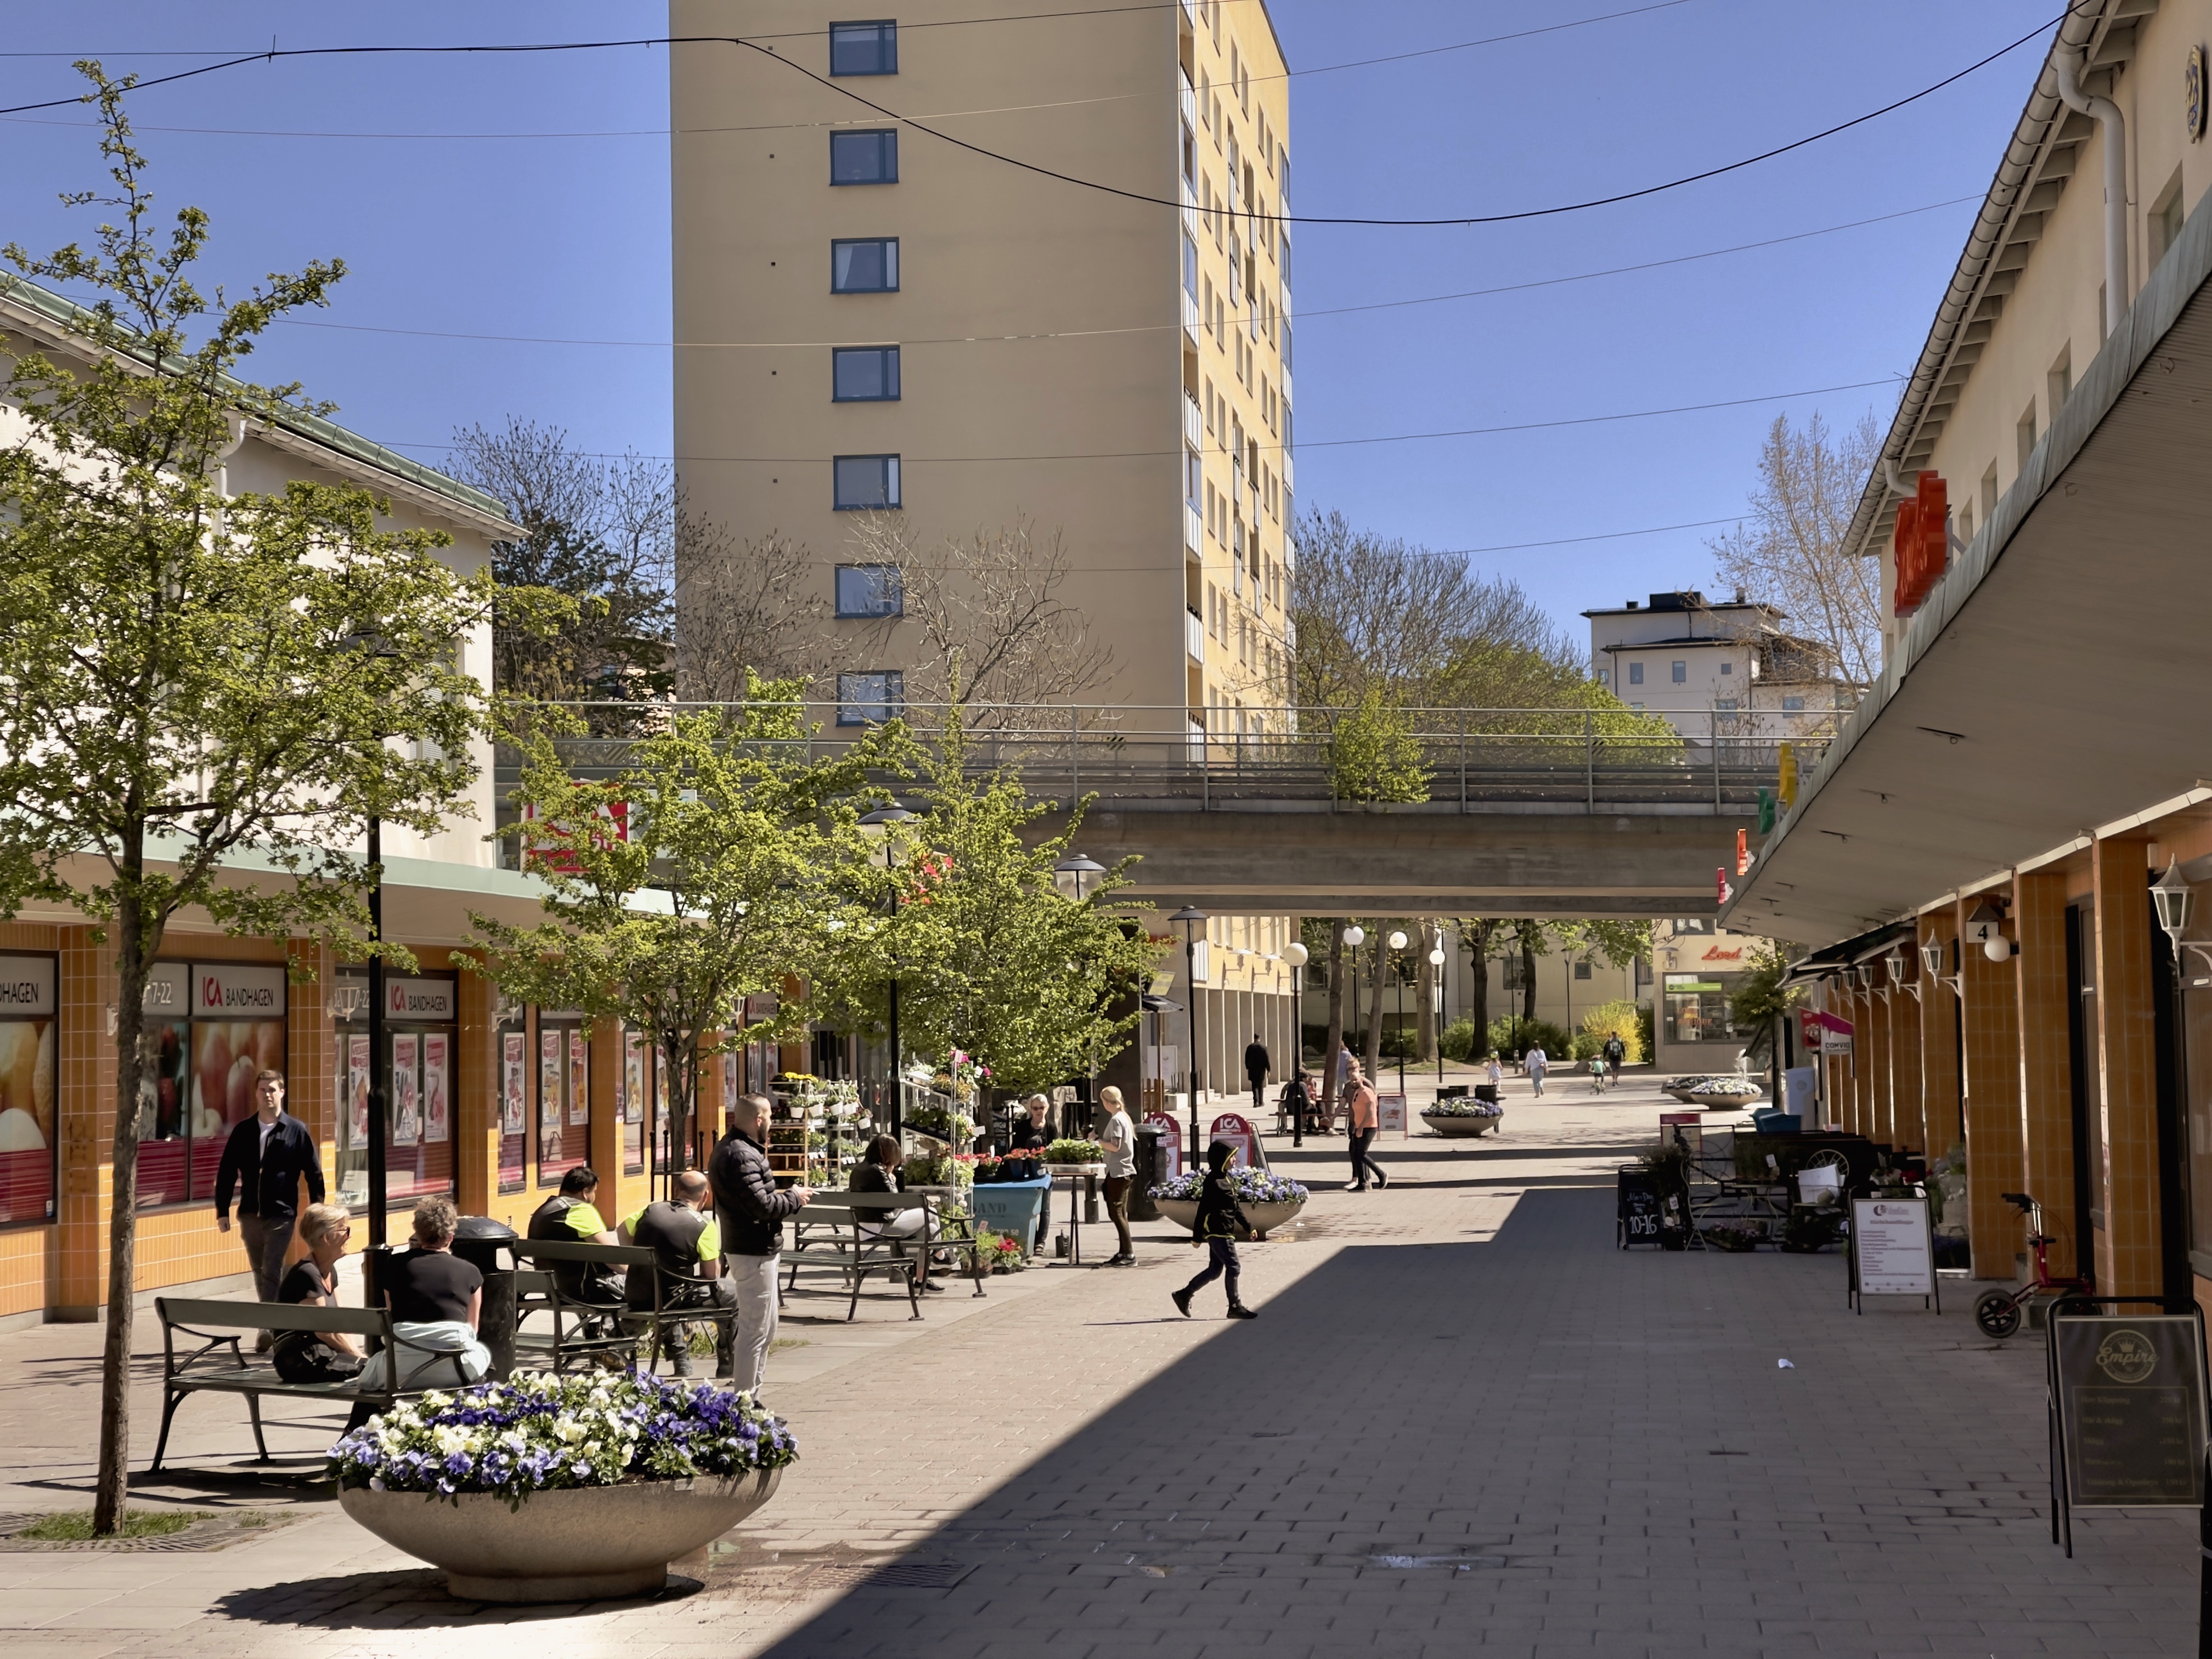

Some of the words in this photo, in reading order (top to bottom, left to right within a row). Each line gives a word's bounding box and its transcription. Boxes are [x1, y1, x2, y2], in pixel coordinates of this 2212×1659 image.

[1978, 924, 1988, 940] 4
[1701, 945, 1742, 960] Lord
[202, 977, 223, 1007] ICA
[227, 989, 274, 1007] BANDHAGEN
[390, 985, 407, 1011] ICA
[408, 995, 447, 1012] BANDHAGEN
[1150, 1117, 1170, 1128] ICA
[1220, 1118, 1241, 1128] ICA
[2095, 1345, 2160, 1366] Empire
